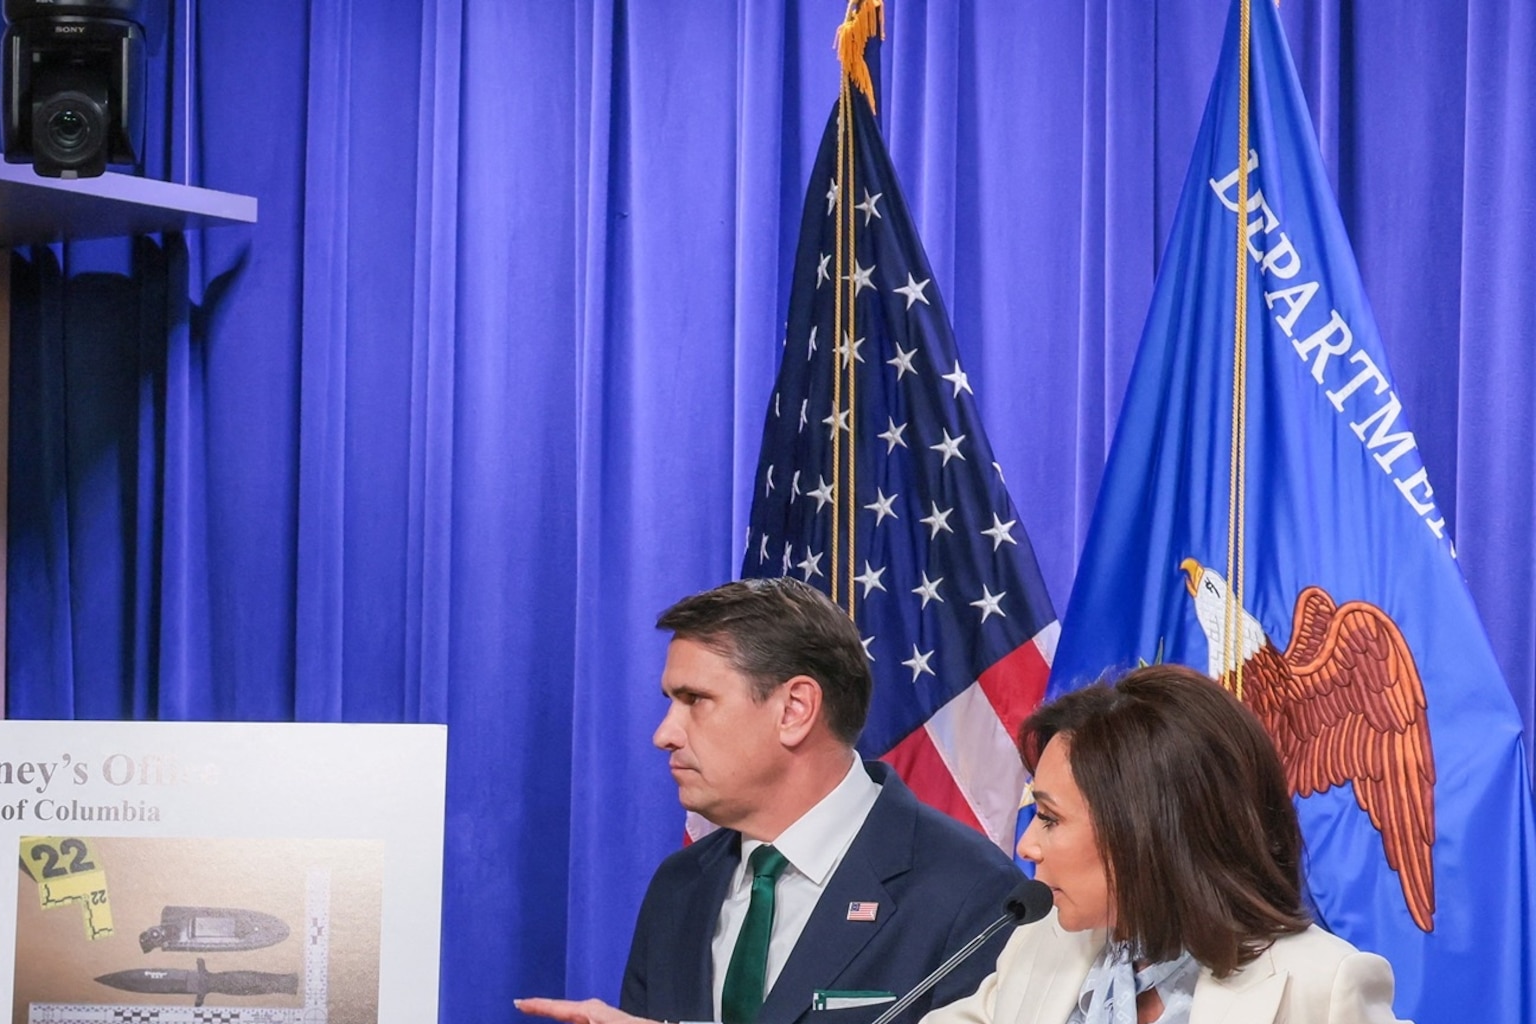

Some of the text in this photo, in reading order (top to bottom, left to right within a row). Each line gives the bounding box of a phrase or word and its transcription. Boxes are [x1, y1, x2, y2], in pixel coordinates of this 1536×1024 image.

[1209, 148, 1457, 559] DEPARTME
[102, 752, 218, 787] Offie
[1, 798, 27, 821] of
[34, 799, 161, 822] Columbia
[31, 838, 95, 878] 22
[90, 889, 107, 905] 22
